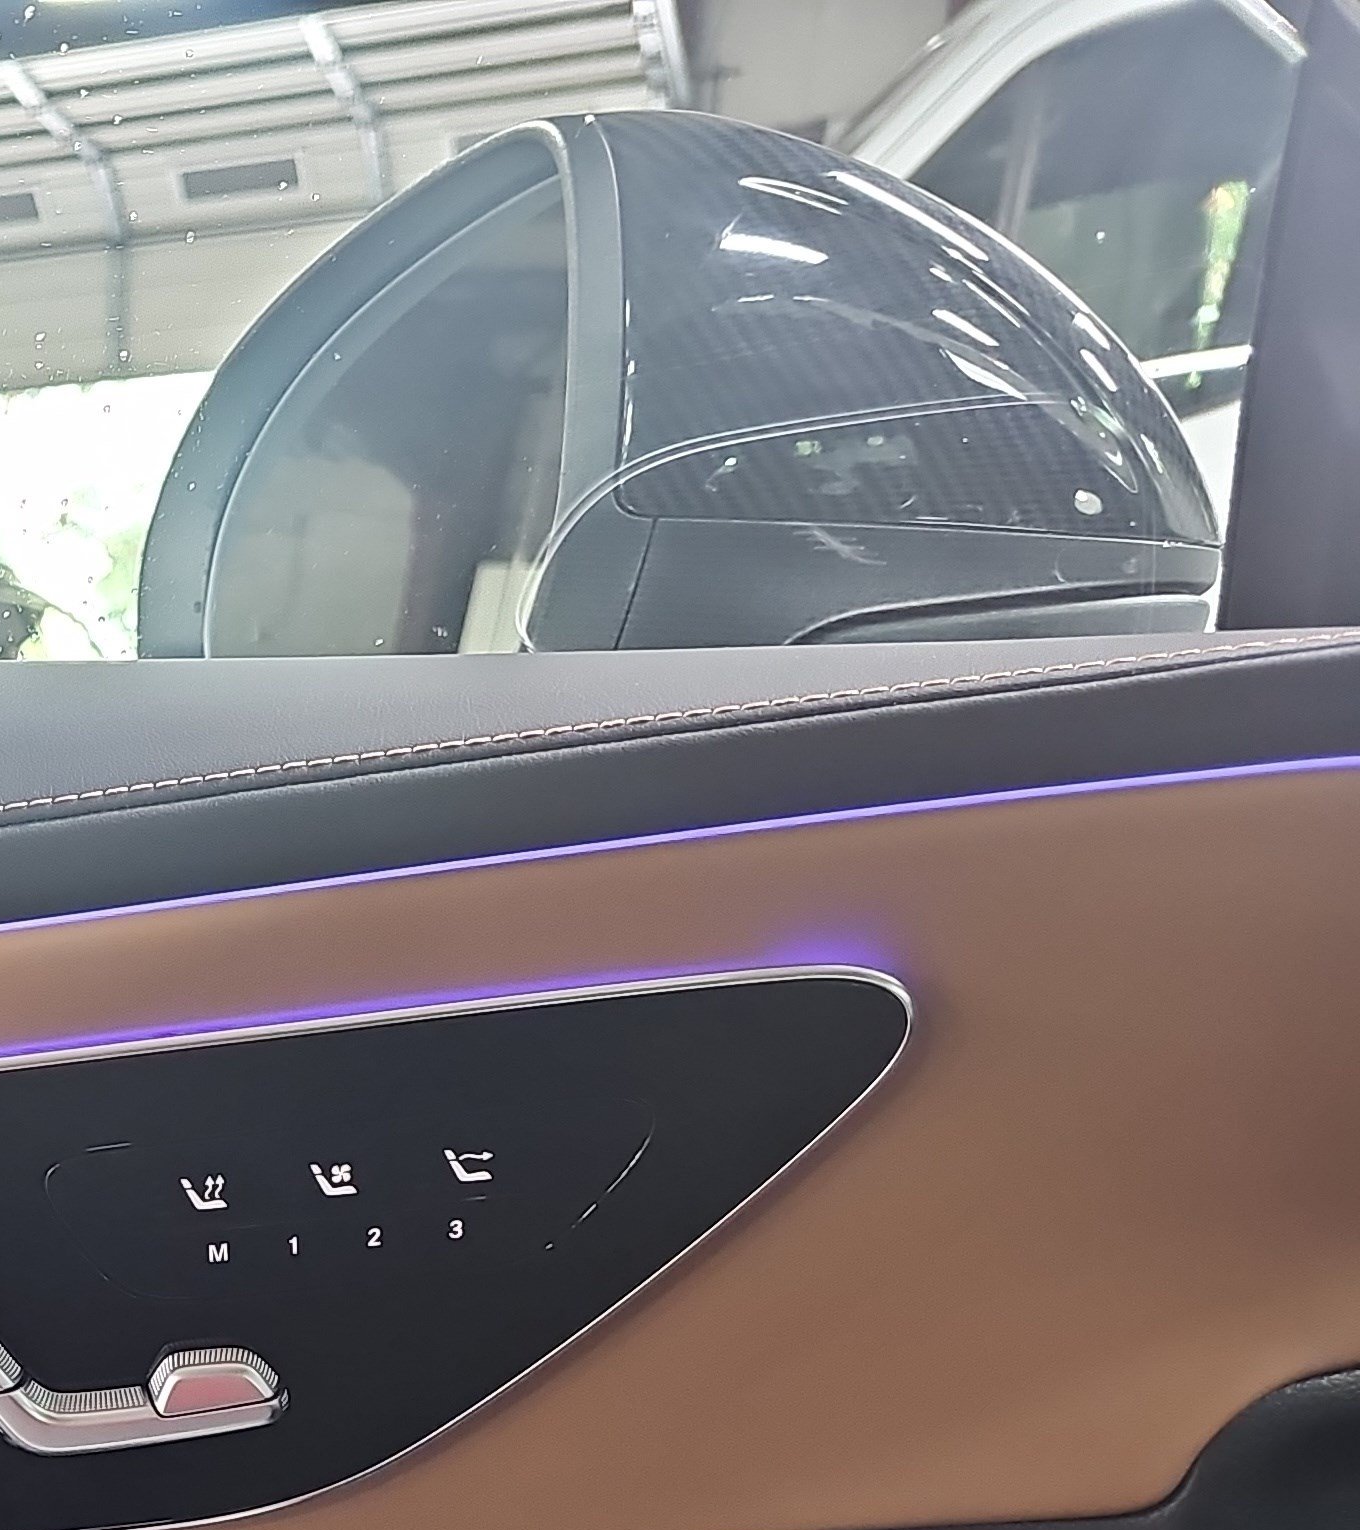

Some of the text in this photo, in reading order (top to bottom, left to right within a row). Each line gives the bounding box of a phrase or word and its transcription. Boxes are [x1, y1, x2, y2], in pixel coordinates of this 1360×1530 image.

[208, 1220, 464, 1262] M 1 2 3
